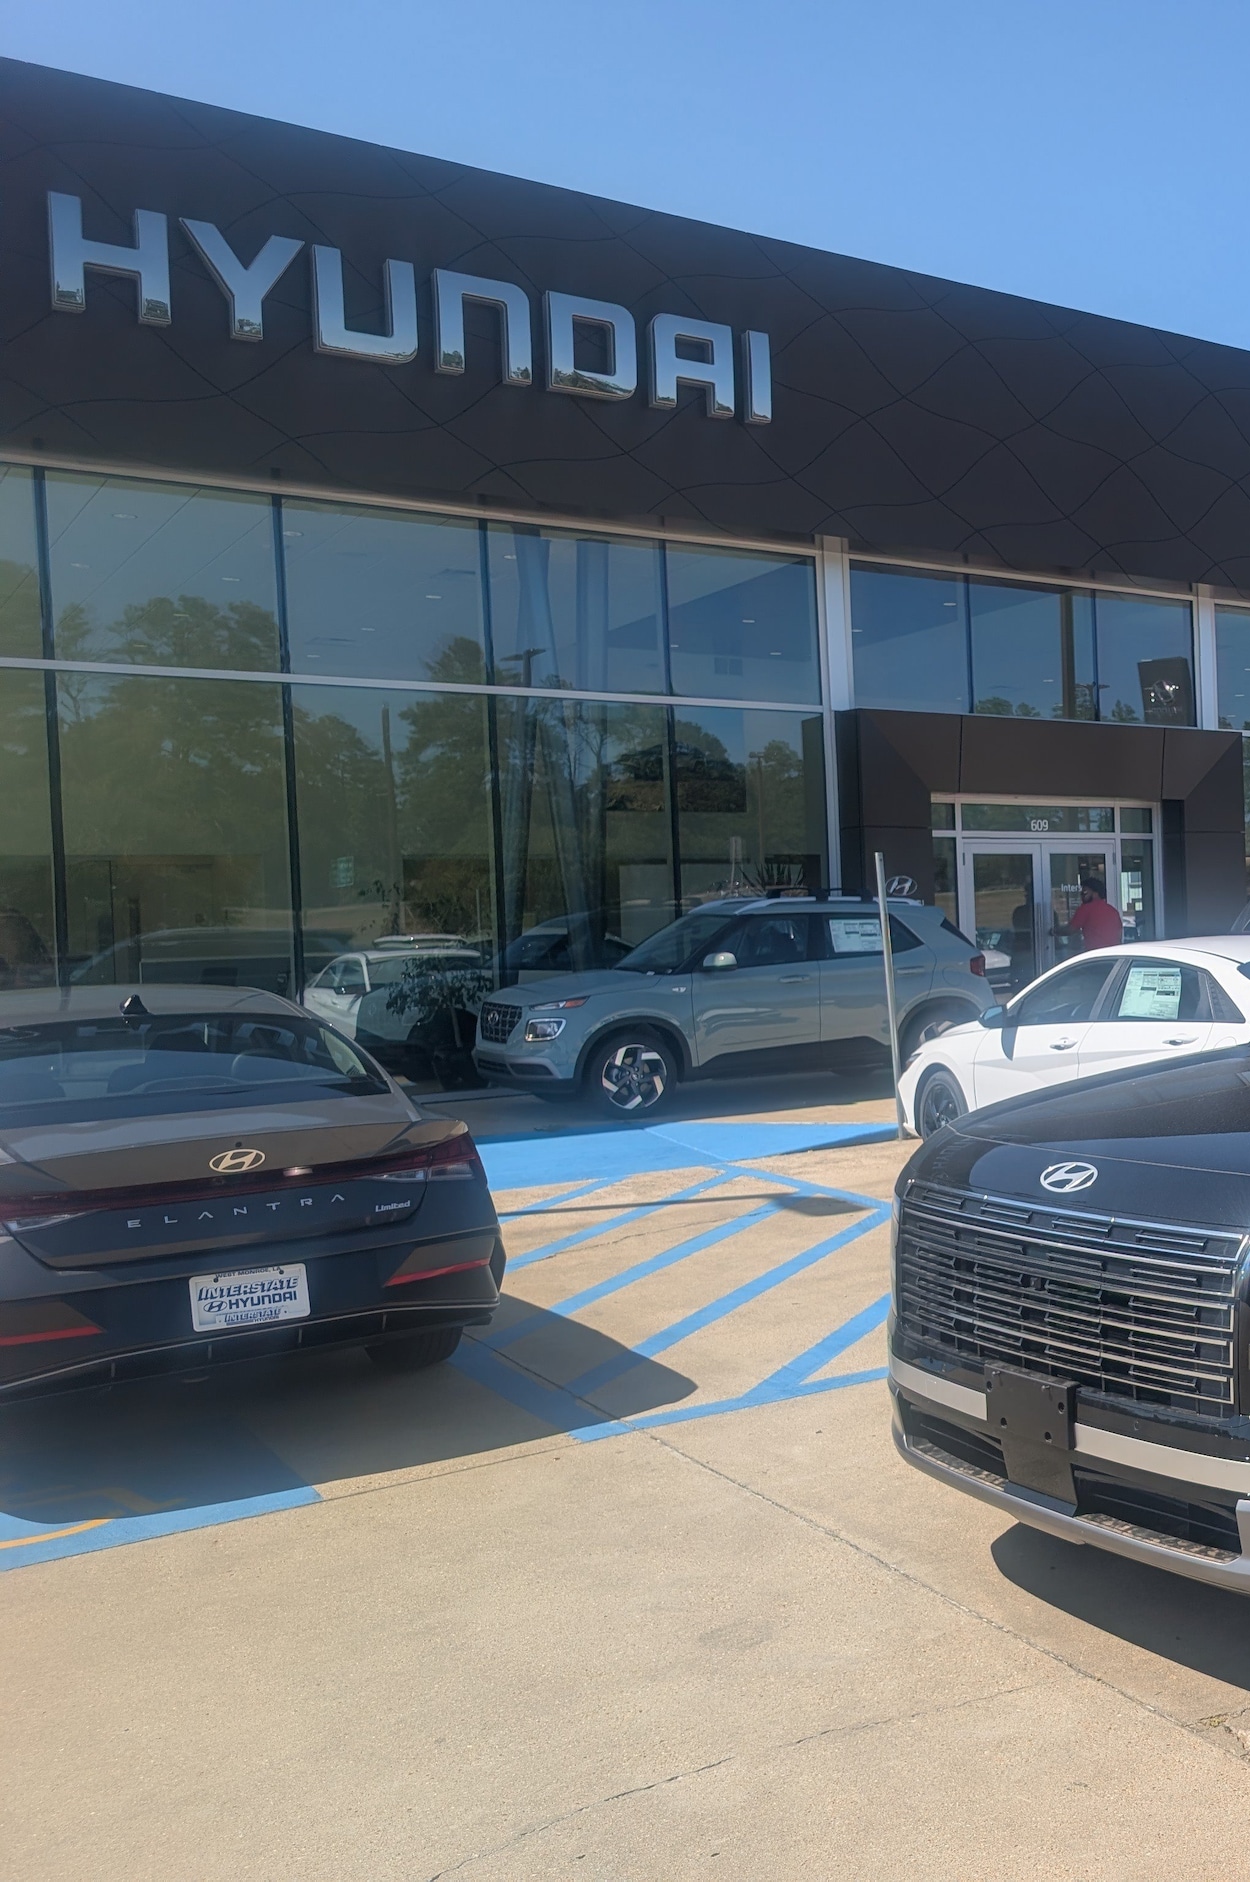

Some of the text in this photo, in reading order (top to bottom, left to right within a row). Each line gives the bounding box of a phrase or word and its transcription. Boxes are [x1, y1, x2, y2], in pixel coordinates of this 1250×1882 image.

[48, 191, 773, 425] HYUNDAI
[1031, 820, 1048, 831] 609
[127, 1193, 411, 1229] ELANTRA Limited
[198, 1275, 300, 1302] INTERSTATE
[228, 1290, 298, 1310] HYUNDAI
